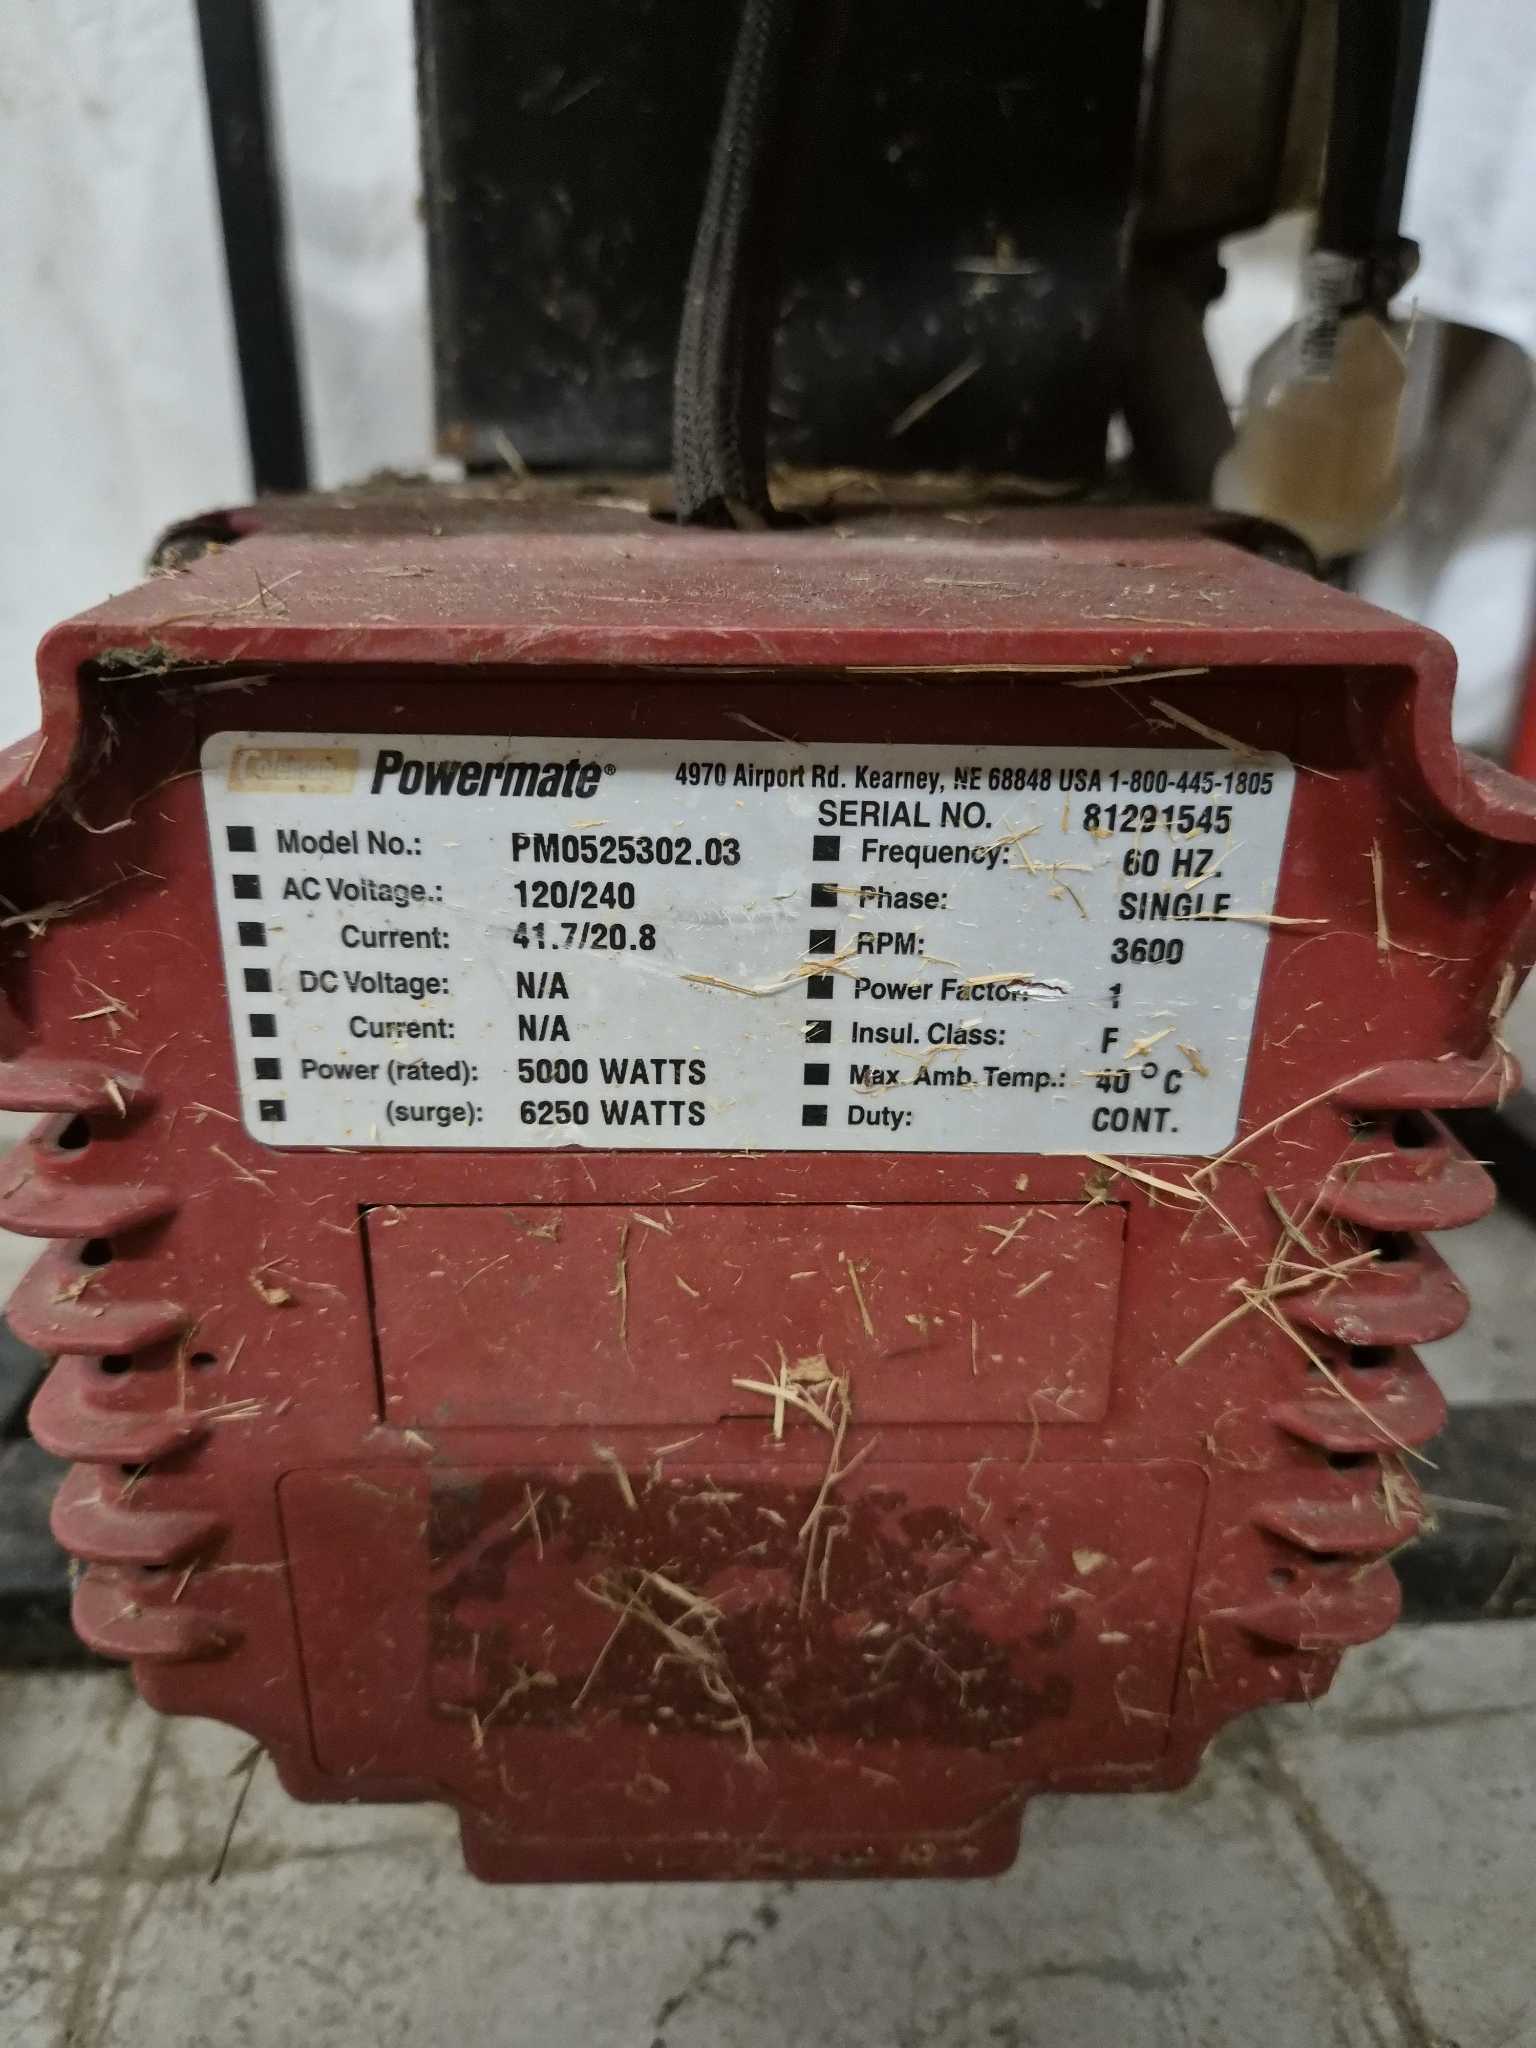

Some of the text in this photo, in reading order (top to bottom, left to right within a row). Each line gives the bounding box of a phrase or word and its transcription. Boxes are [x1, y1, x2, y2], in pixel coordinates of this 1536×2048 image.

[675, 762, 1274, 795] 4970 Airport Rd. Kearney, NE 68848 USA 1-800-445-1805
[818, 800, 931, 828] SERIAL
[940, 802, 993, 829] NO.
[276, 829, 741, 866] Model No.: PM0525302.03
[862, 839, 1222, 878] Frequency: 60 HZ.
[283, 877, 321, 901] AC
[514, 880, 636, 909] 120/240
[859, 886, 1231, 922] Phase: SINGLE
[342, 922, 656, 951] Current: 41.7/20.8
[857, 932, 1184, 965] RPM: 3600
[300, 970, 570, 1000] DC Voltage: N/A
[855, 977, 1122, 1009] Power Factor: 1
[350, 1015, 571, 1042] Current: N/A
[852, 1022, 1119, 1053] Insul. Class: F
[302, 1058, 706, 1086] Power (rated): 5000 WATTS
[983, 1066, 1066, 1092] Temp.:
[1095, 1068, 1130, 1094] 40
[386, 1101, 706, 1126] (surge): 6250 WATTS
[847, 1105, 1179, 1133] Duty: CONT.
